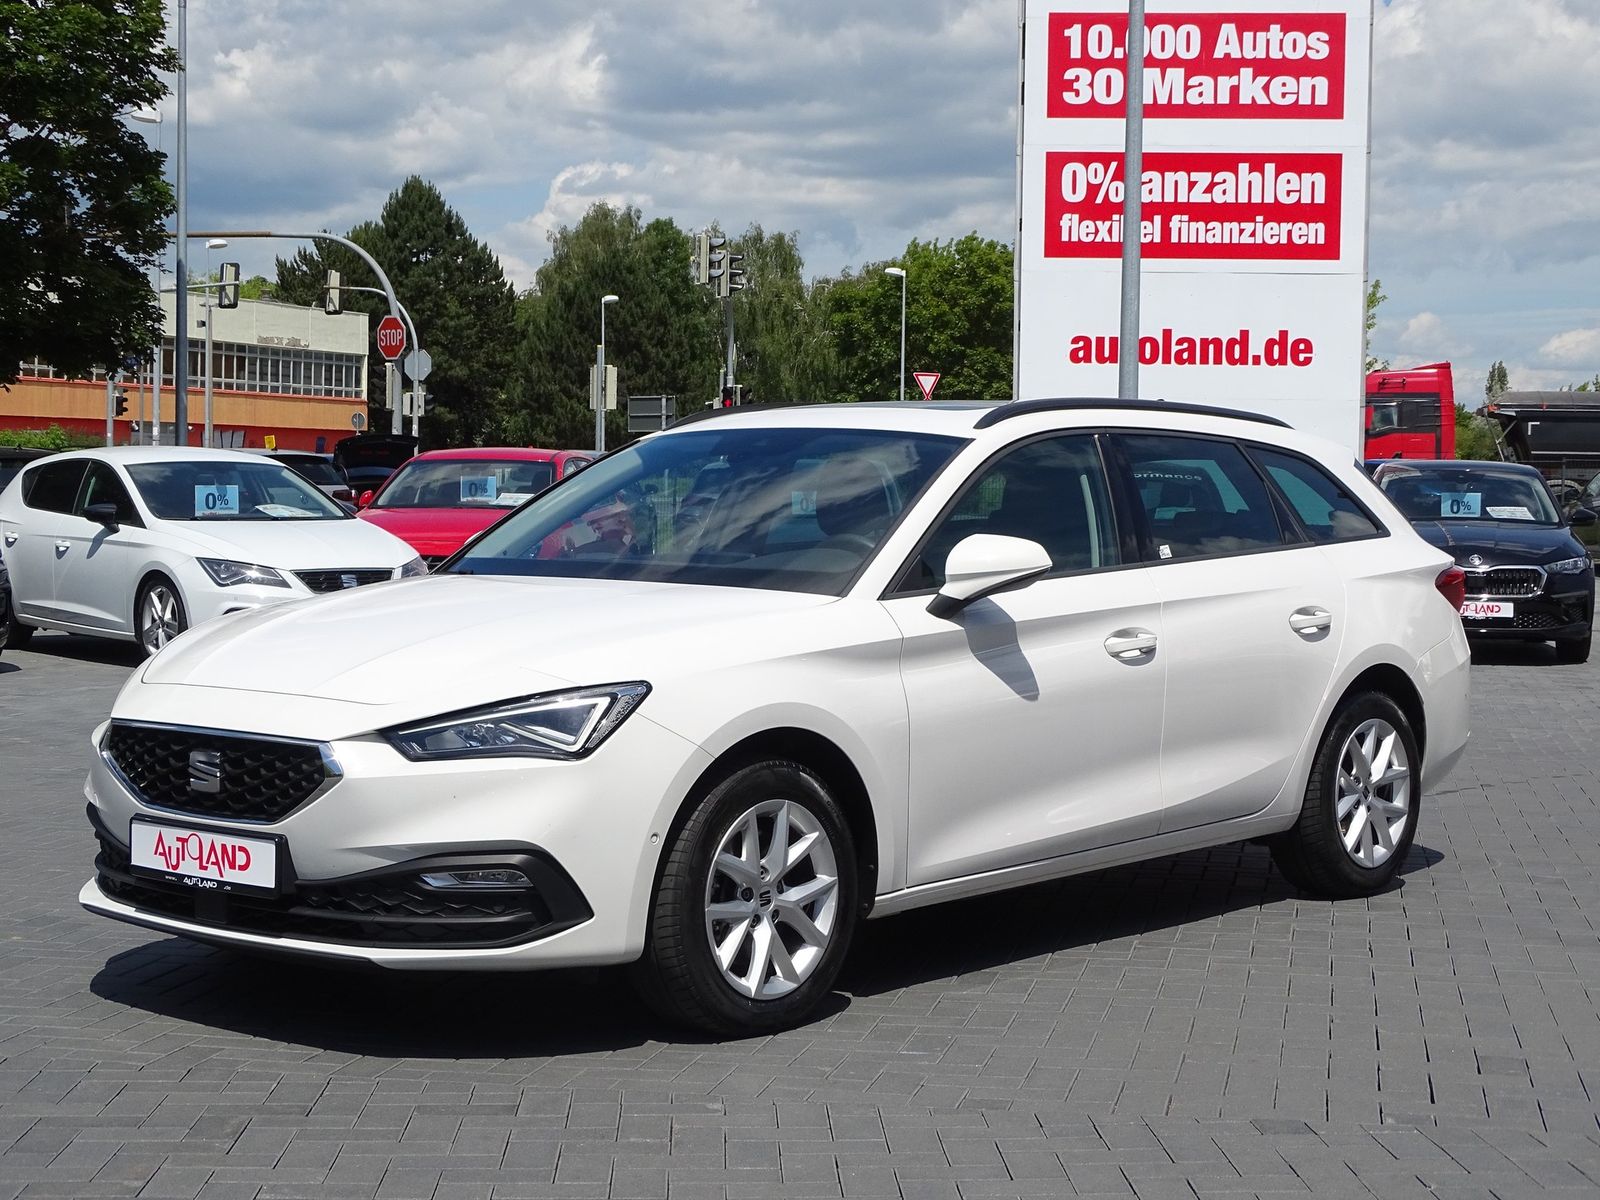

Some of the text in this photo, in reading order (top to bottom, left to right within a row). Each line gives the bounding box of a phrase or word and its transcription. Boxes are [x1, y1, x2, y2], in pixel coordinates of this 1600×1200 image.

[1213, 23, 1330, 60] Autos
[1062, 67, 1329, 106] 30 Marken
[1061, 161, 1327, 205] 0% anzahlen
[1059, 213, 1326, 246] flexiel finanzieren
[380, 329, 403, 346] STOP
[1069, 328, 1314, 367] auoland.de
[204, 492, 229, 510] 0%
[467, 481, 489, 497] 0%
[1449, 499, 1472, 515] 0%
[153, 829, 252, 879] AUTOLAND
[183, 876, 218, 889] AUTOLAND
